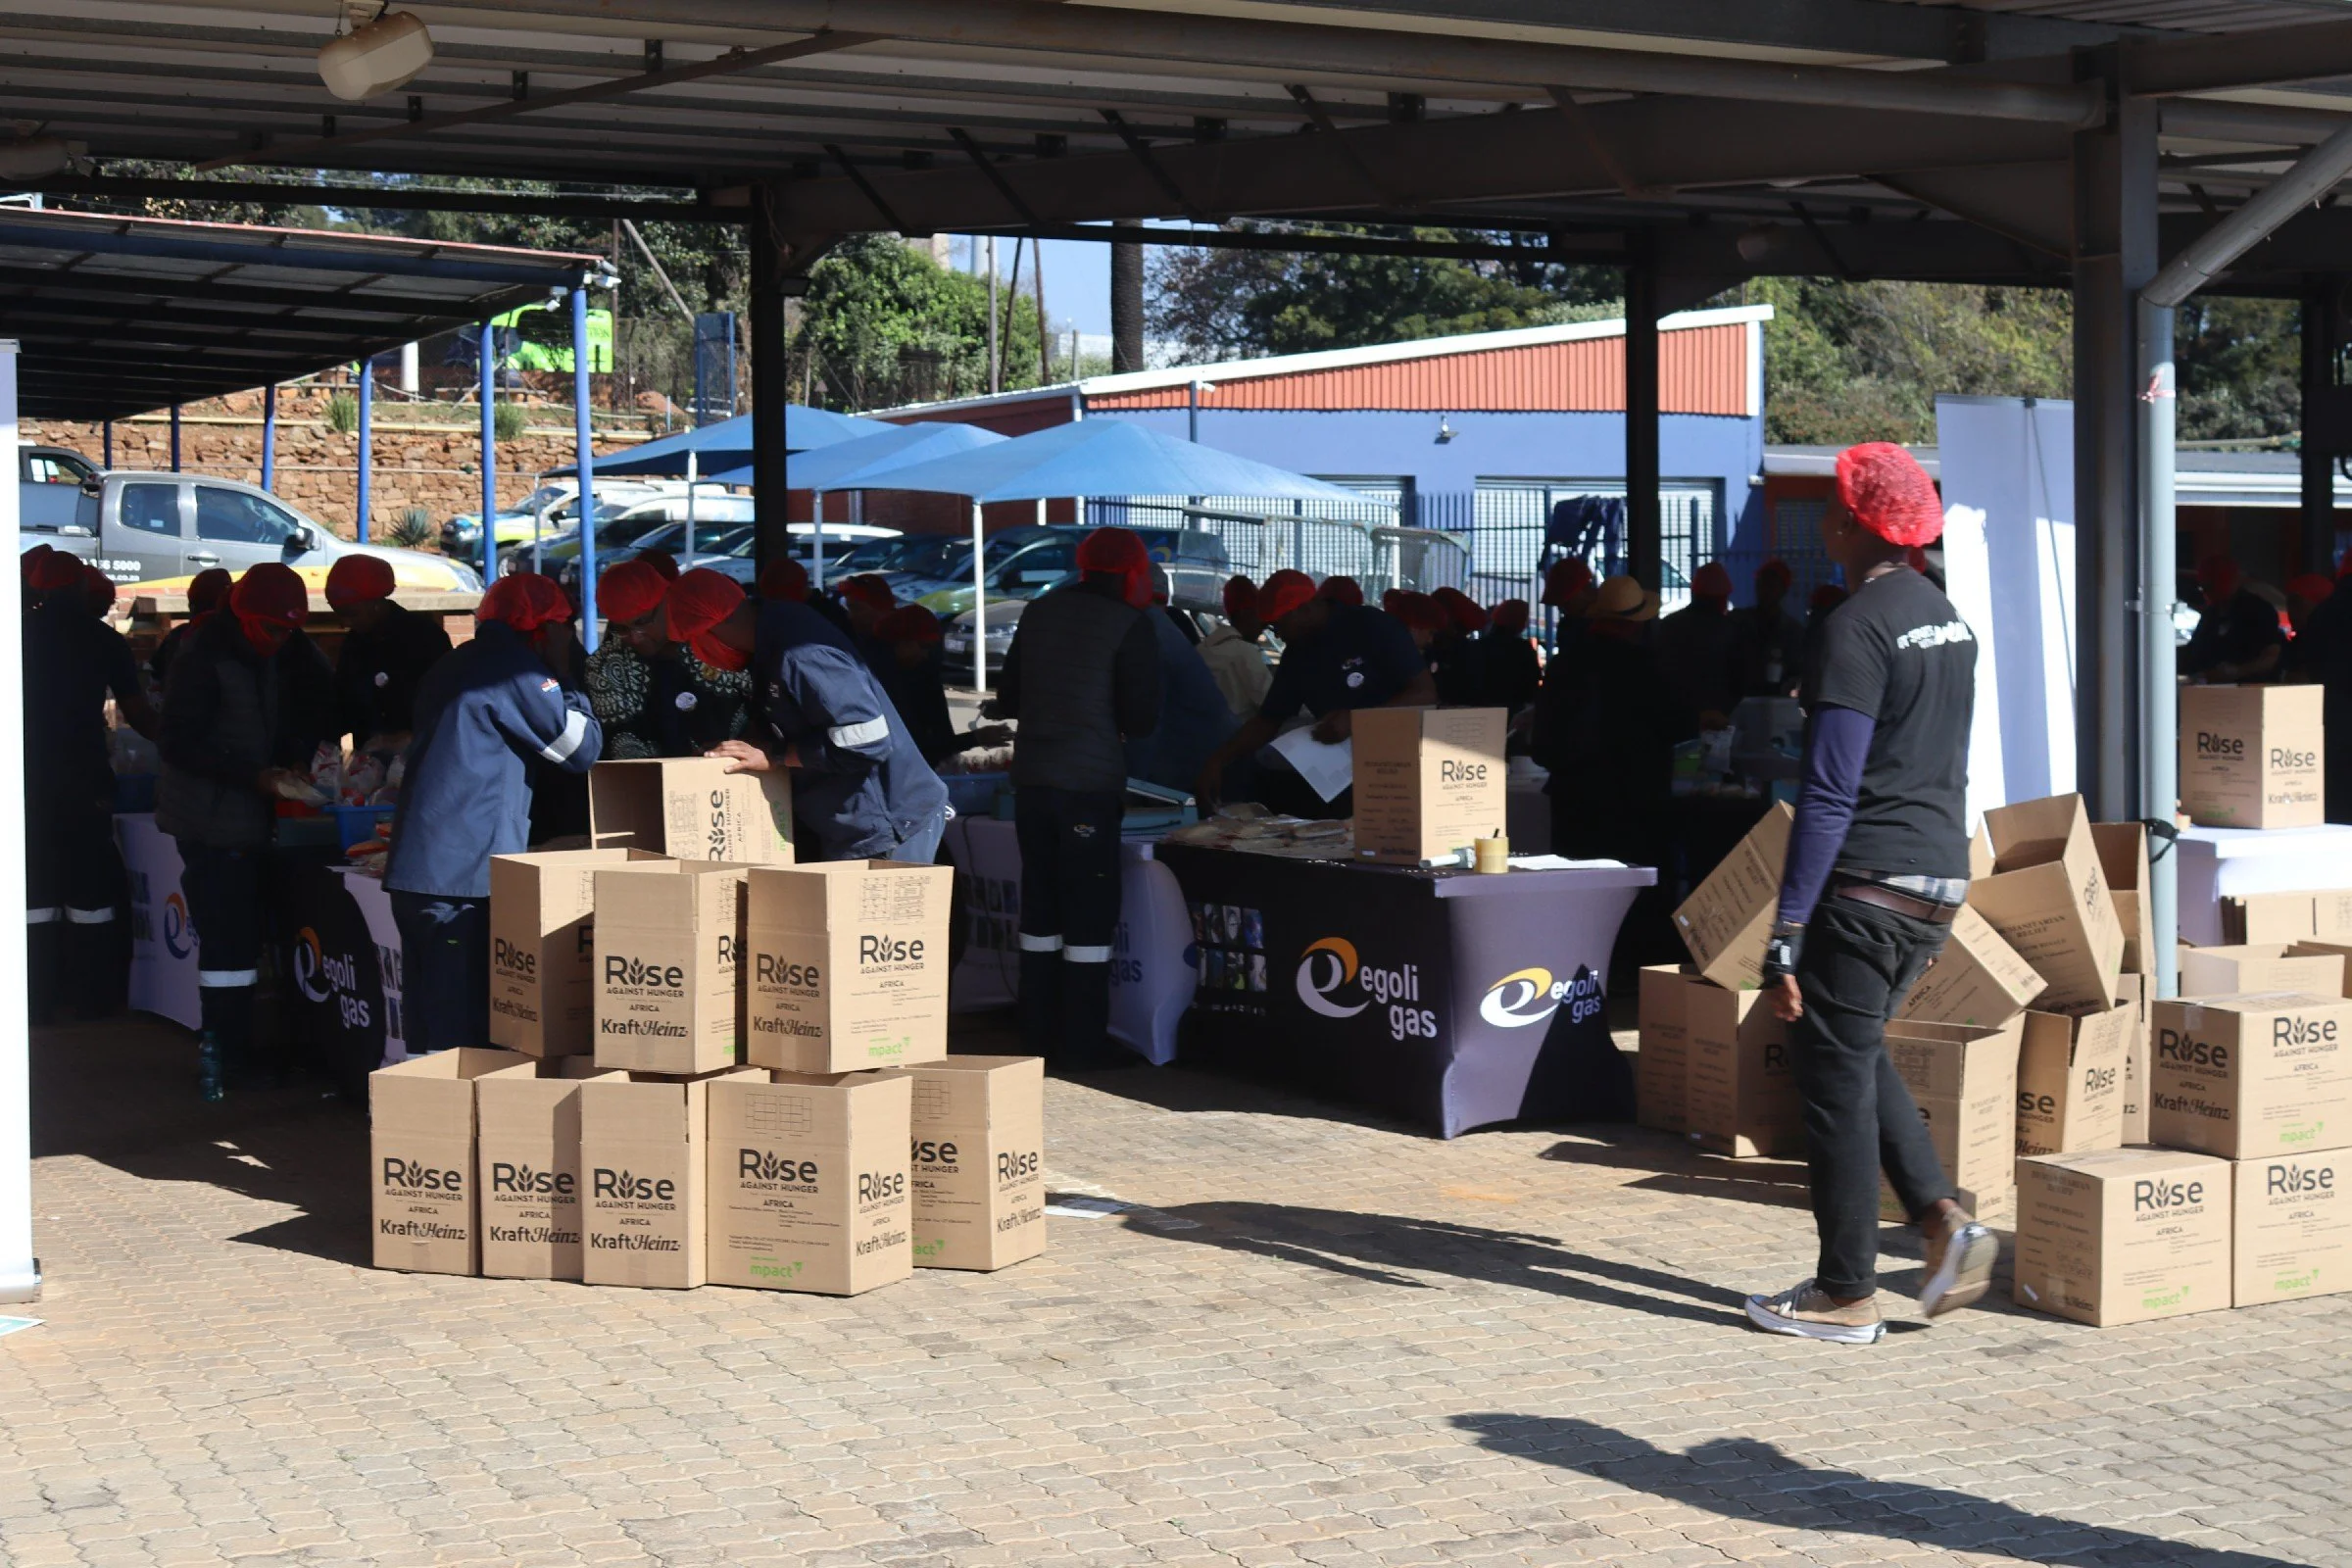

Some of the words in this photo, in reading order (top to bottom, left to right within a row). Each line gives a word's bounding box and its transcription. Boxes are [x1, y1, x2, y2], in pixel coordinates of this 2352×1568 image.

[113, 560, 141, 570] 5000
[2197, 732, 2244, 754] Rise
[2271, 748, 2316, 768] Rise
[1442, 760, 1488, 782] Rise
[495, 938, 536, 975] Rise
[860, 934, 924, 964] Rise
[322, 954, 356, 992] egoli
[606, 956, 684, 988] Rise
[757, 954, 819, 987] Rise
[1360, 963, 1418, 1004] egoli
[1550, 970, 1598, 1004] egoli
[340, 994, 370, 1029] gas
[1390, 1004, 1438, 1041] gas
[1572, 996, 1600, 1023] gas
[2274, 1015, 2337, 1047] Rise
[2159, 1028, 2228, 1068] Rise
[2084, 1067, 2116, 1094] Rise
[2018, 1092, 2055, 1114] se
[384, 1157, 462, 1191] Rise
[493, 1163, 574, 1194] Rise
[739, 1149, 818, 1183] Rise
[922, 1164, 959, 1174] HUNGER
[998, 1151, 1038, 1183] Rise
[2268, 1163, 2334, 1195] Rise
[385, 1189, 422, 1198] AGAINST
[425, 1192, 463, 1201] HUNGER
[594, 1168, 675, 1200] Rise
[740, 1181, 778, 1191] AGAINST
[780, 1184, 818, 1194] HUNGER
[858, 1171, 904, 1204] Rise
[2134, 1177, 2203, 1211] Rise
[409, 1206, 439, 1215] AFRICA
[537, 1196, 576, 1204] HUNGER
[763, 1200, 794, 1208] AFRICA
[912, 1244, 936, 1255] act
[751, 1264, 793, 1278] mpact
